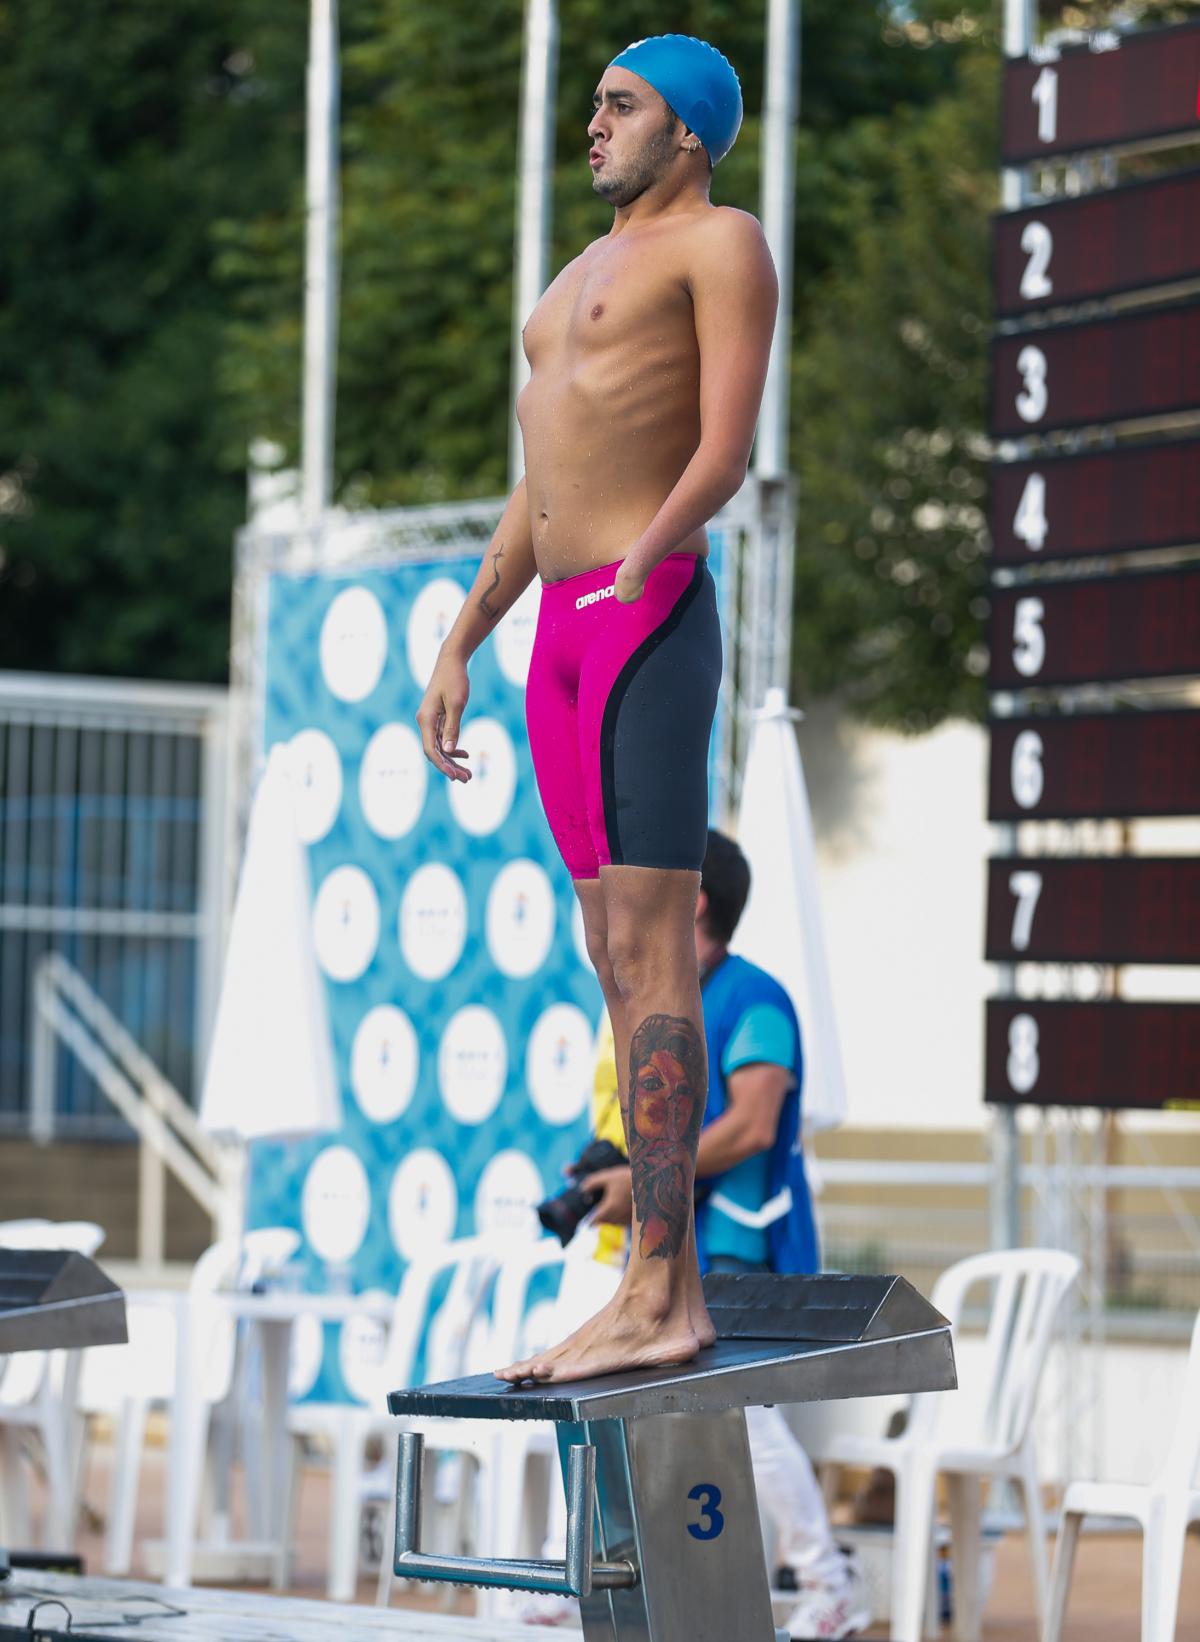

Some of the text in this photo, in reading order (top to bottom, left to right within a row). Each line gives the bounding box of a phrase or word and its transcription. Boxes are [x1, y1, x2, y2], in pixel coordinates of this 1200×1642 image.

[1032, 67, 1058, 143] 1
[1020, 221, 1053, 300] 2
[1016, 346, 1048, 422] 3
[1013, 473, 1048, 551] 4
[1012, 597, 1046, 676] 5
[1011, 730, 1044, 808] 6
[1009, 871, 1042, 951] 7
[1007, 1014, 1039, 1093] 8
[687, 1484, 724, 1540] 3
